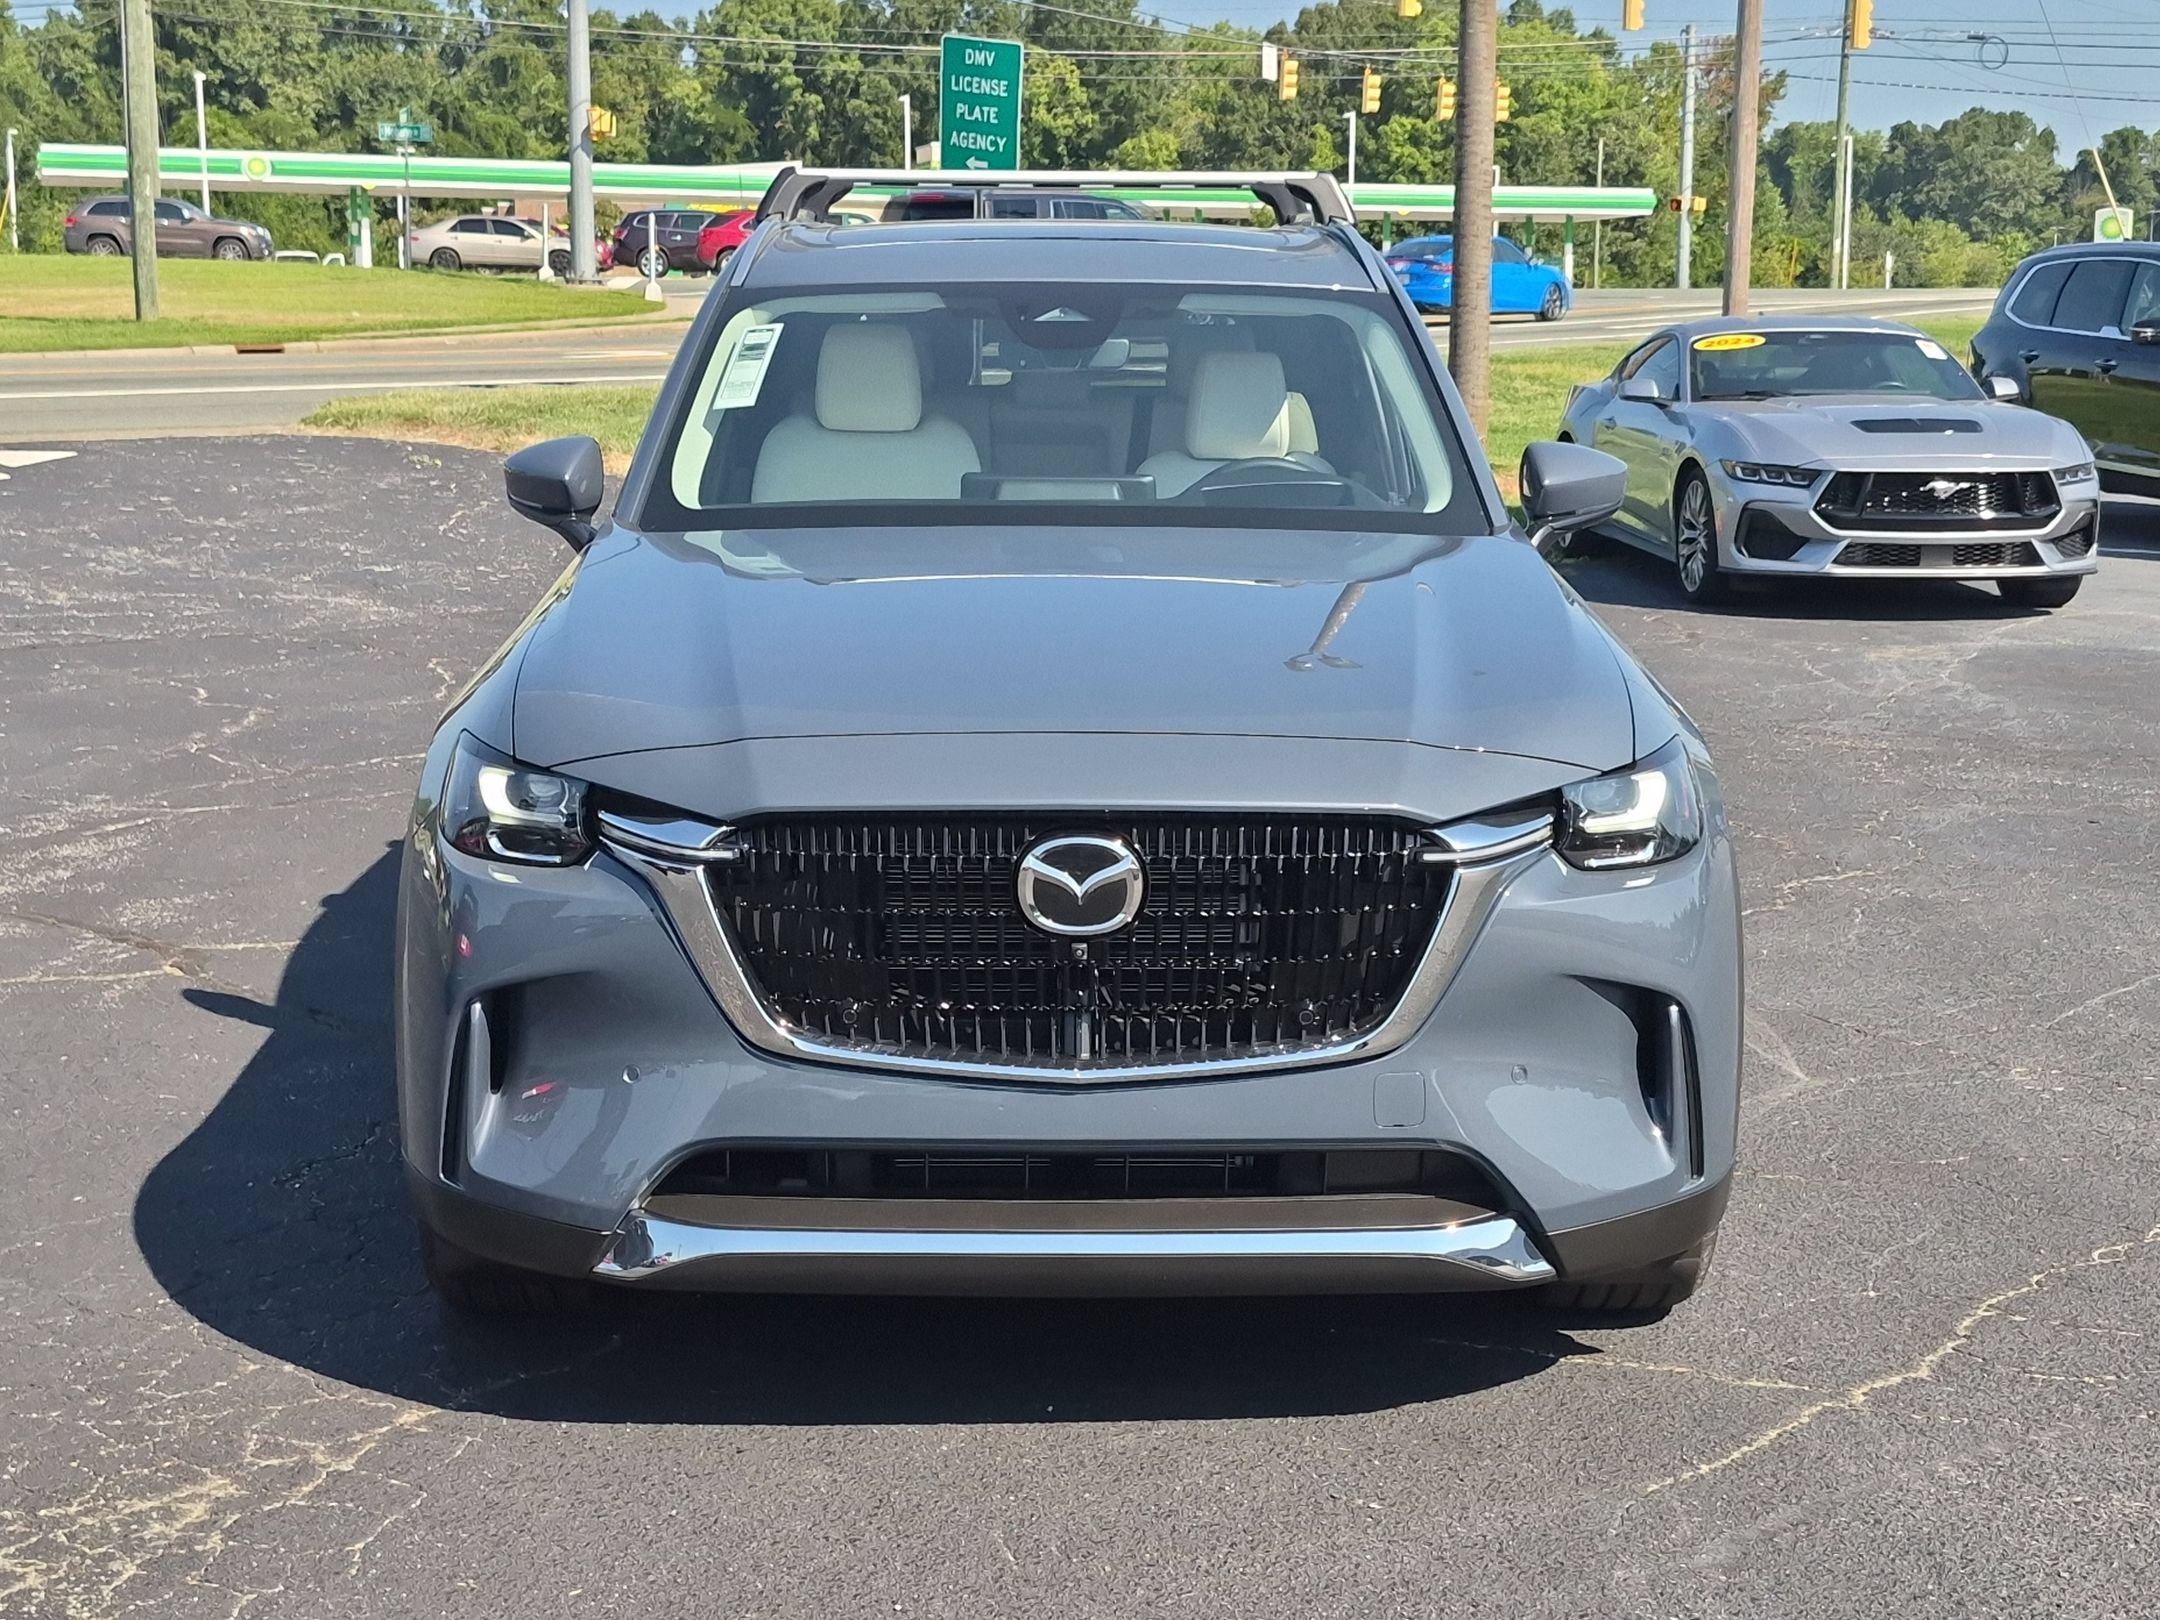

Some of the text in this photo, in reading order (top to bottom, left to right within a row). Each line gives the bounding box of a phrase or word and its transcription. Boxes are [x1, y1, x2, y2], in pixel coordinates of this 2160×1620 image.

[965, 48, 995, 67] DMV
[951, 74, 1008, 97] LICENSE
[956, 102, 999, 124] PLATE
[950, 130, 1007, 153] AGENCY
[1703, 337, 1756, 348] 2024
